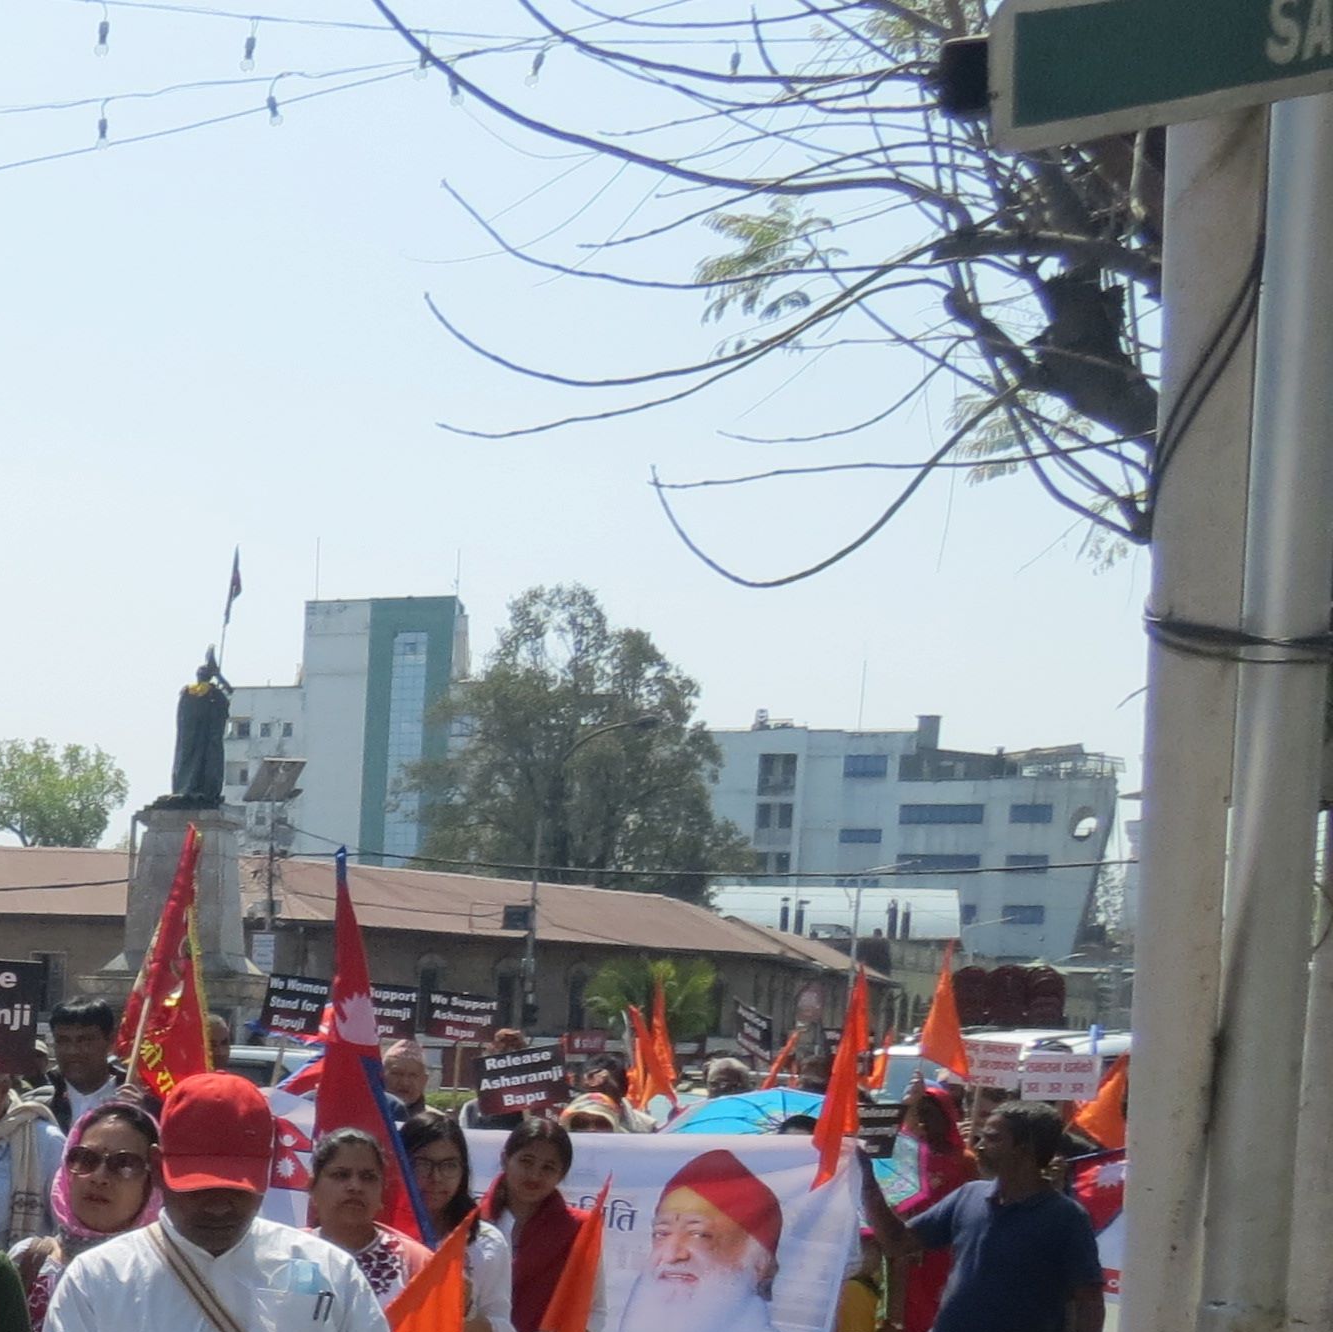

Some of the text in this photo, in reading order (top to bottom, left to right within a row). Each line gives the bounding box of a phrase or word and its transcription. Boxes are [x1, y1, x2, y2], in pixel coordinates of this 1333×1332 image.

[270, 977, 328, 996] We Women
[270, 995, 319, 1012] Stand for
[431, 993, 497, 1012] We Support
[270, 1013, 306, 1031] Bapuji
[433, 1008, 492, 1026] Asharamji
[377, 1024, 394, 1036] pu
[445, 1025, 476, 1039] Bapu
[484, 1050, 552, 1071] Release
[479, 1065, 564, 1091] Asharamji
[502, 1090, 547, 1107] Bapu
